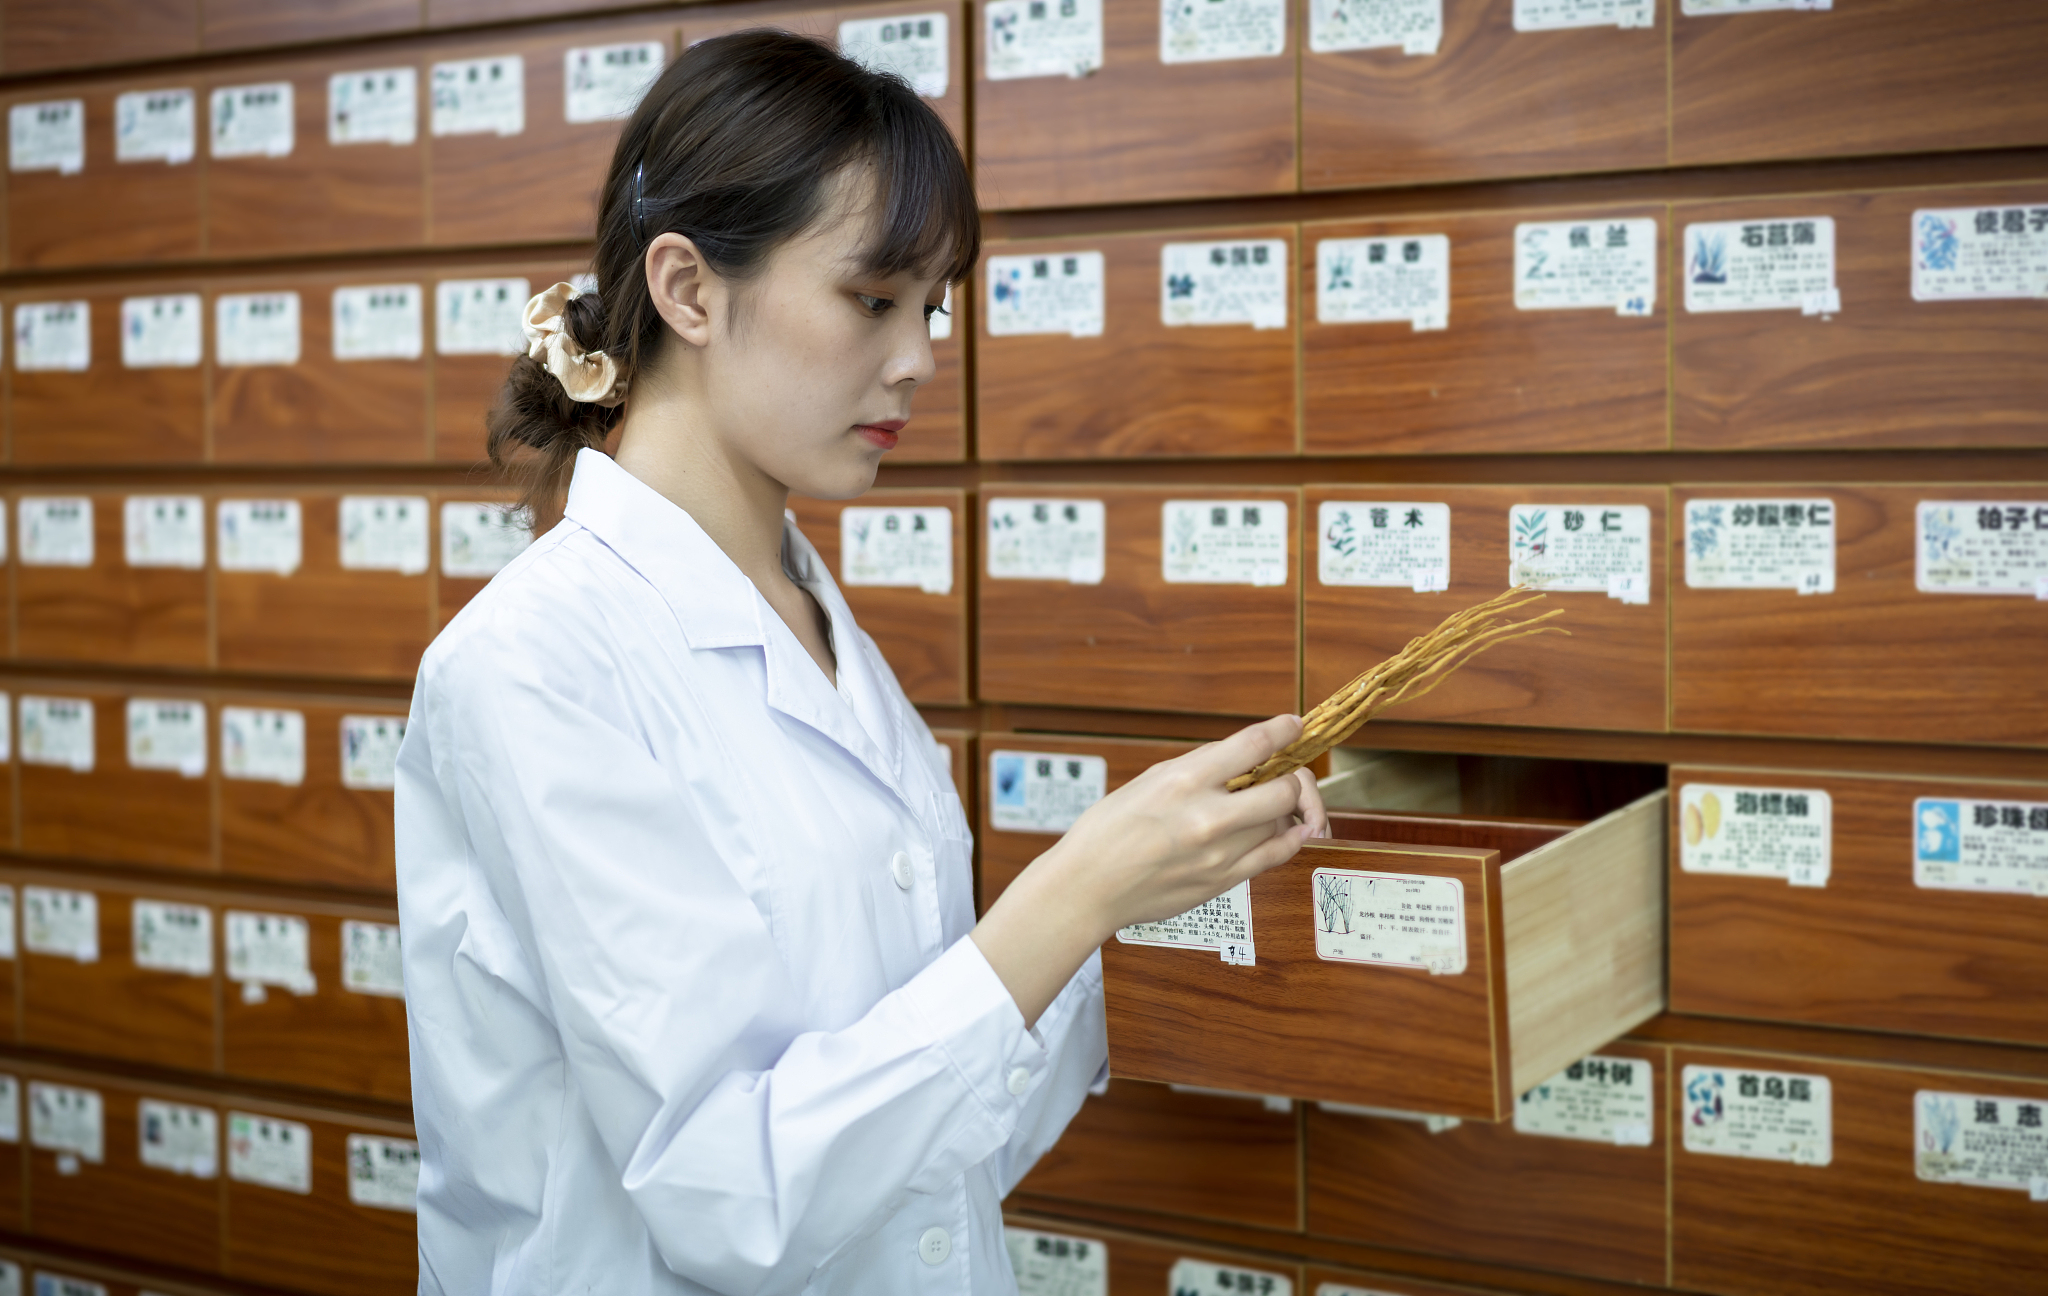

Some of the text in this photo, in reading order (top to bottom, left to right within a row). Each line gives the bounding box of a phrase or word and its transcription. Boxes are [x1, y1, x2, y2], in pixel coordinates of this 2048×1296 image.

[1370, 507, 1424, 529] 苍术
[1563, 510, 1622, 533] 砂仁
[1732, 503, 1832, 527] 炒酸枣仁
[1973, 1100, 2043, 1128] 远志
